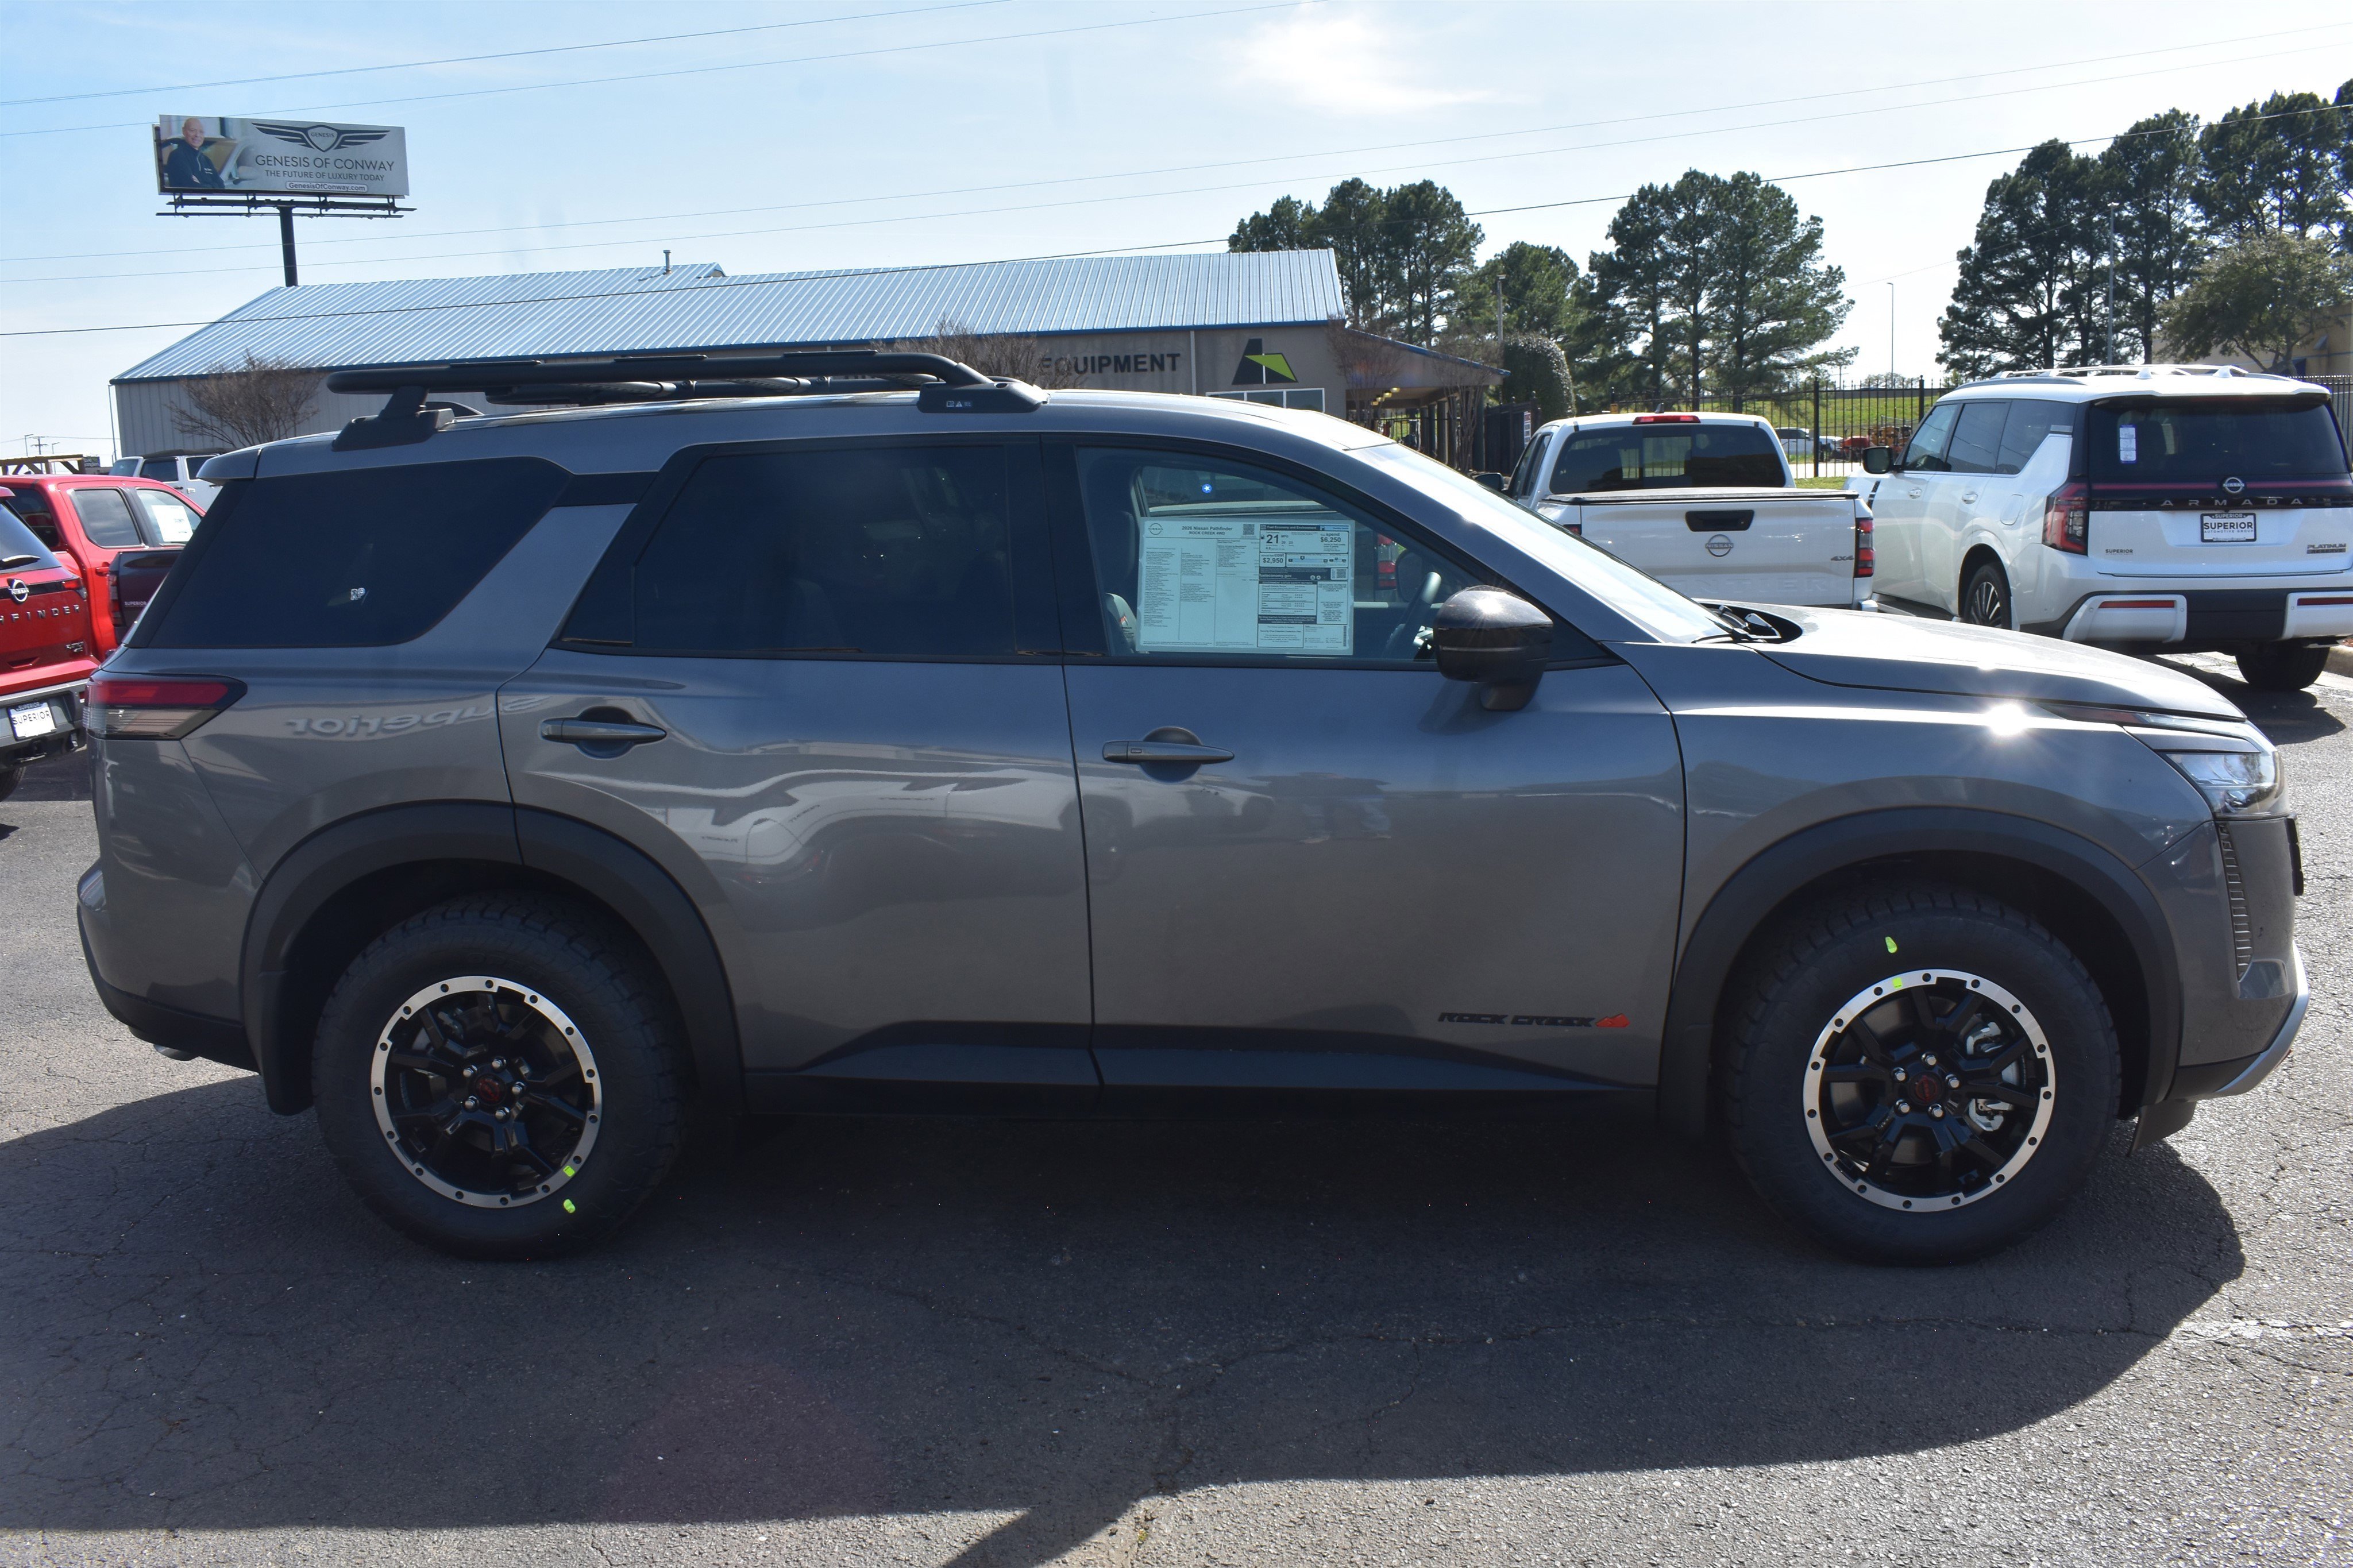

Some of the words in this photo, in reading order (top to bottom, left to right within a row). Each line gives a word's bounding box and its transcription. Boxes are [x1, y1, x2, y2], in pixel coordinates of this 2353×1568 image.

[256, 155, 310, 168] GENESIS
[313, 157, 330, 168] OF
[334, 158, 395, 172] CONWAY
[283, 171, 314, 179] FUTURE
[328, 172, 358, 180] LUXURY
[360, 173, 385, 181] TODAY
[288, 181, 366, 192] GenesisOfConway.com
[1041, 353, 1181, 375] EQUIPMENT
[2161, 498, 2303, 507] ARMADA
[1266, 534, 1279, 544] 21
[11, 710, 52, 725] SUPERIOR
[1438, 1012, 1508, 1024] ROCK
[1511, 1015, 1595, 1027] CREEK
